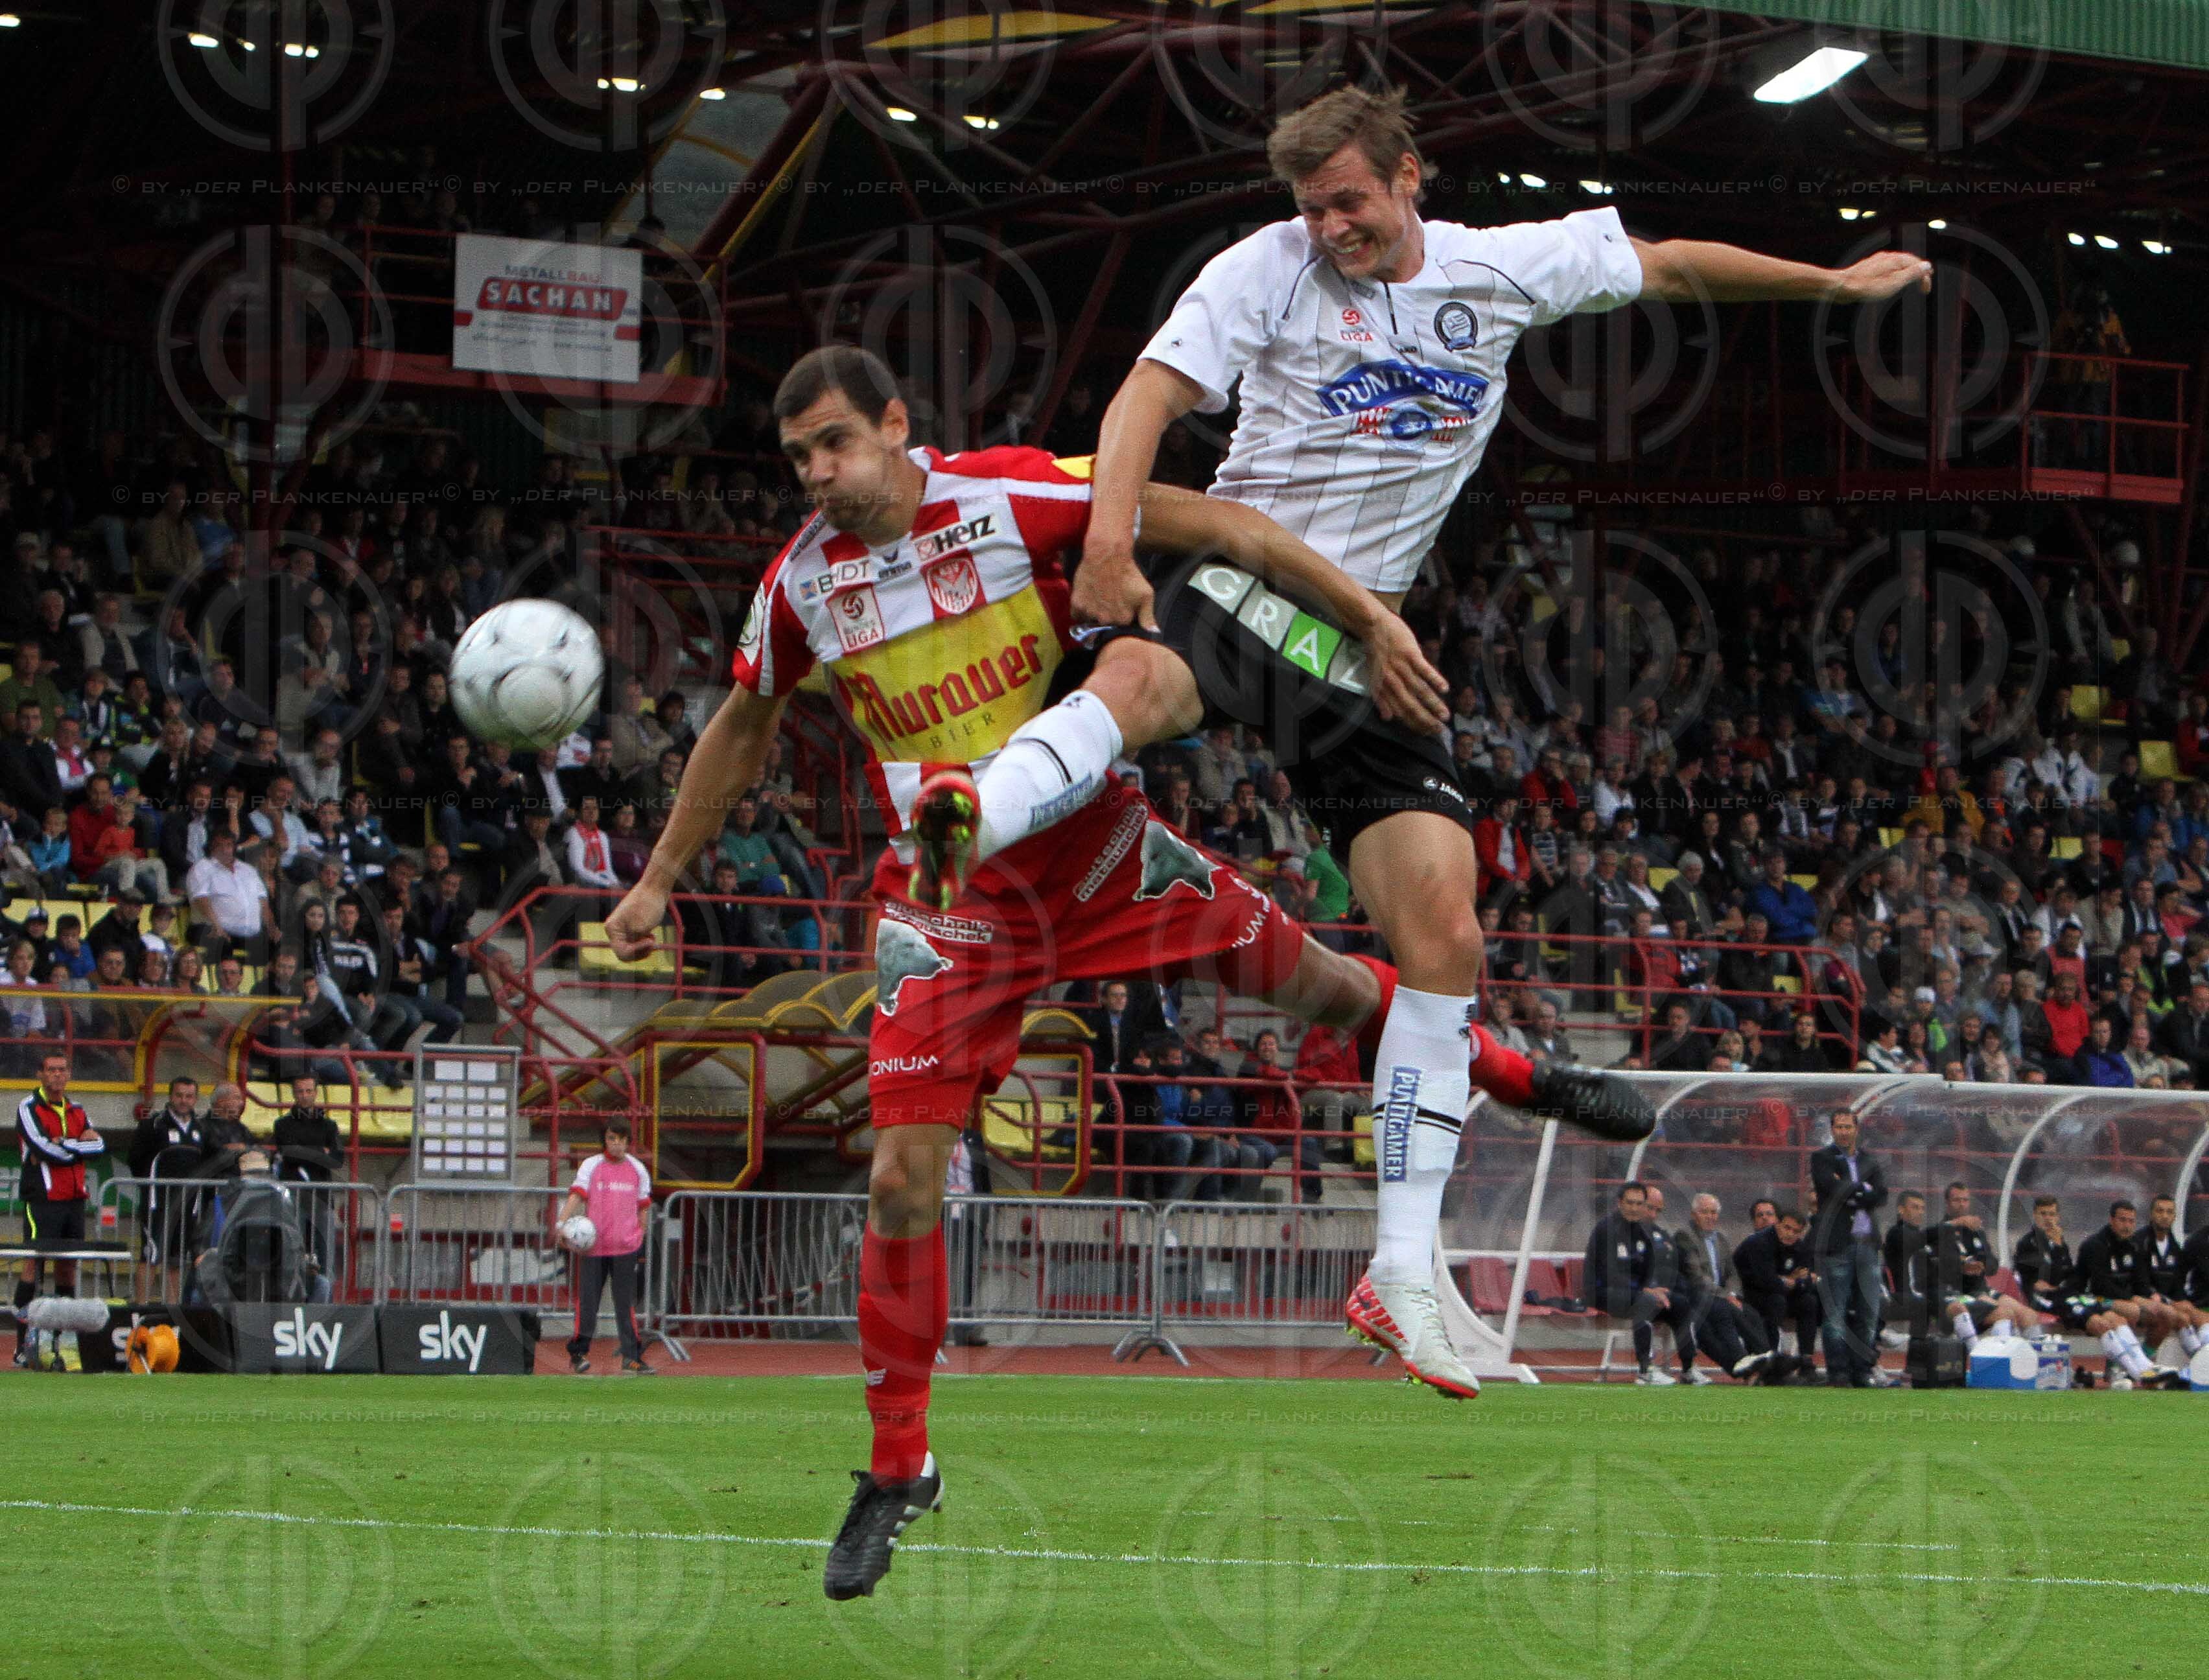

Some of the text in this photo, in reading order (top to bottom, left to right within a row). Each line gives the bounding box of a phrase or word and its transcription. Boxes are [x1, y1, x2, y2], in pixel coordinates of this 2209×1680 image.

[1340, 331, 1373, 342] LIGA
[929, 712, 996, 749] BIER
[273, 1307, 343, 1370] sky
[419, 1310, 487, 1373] sky
